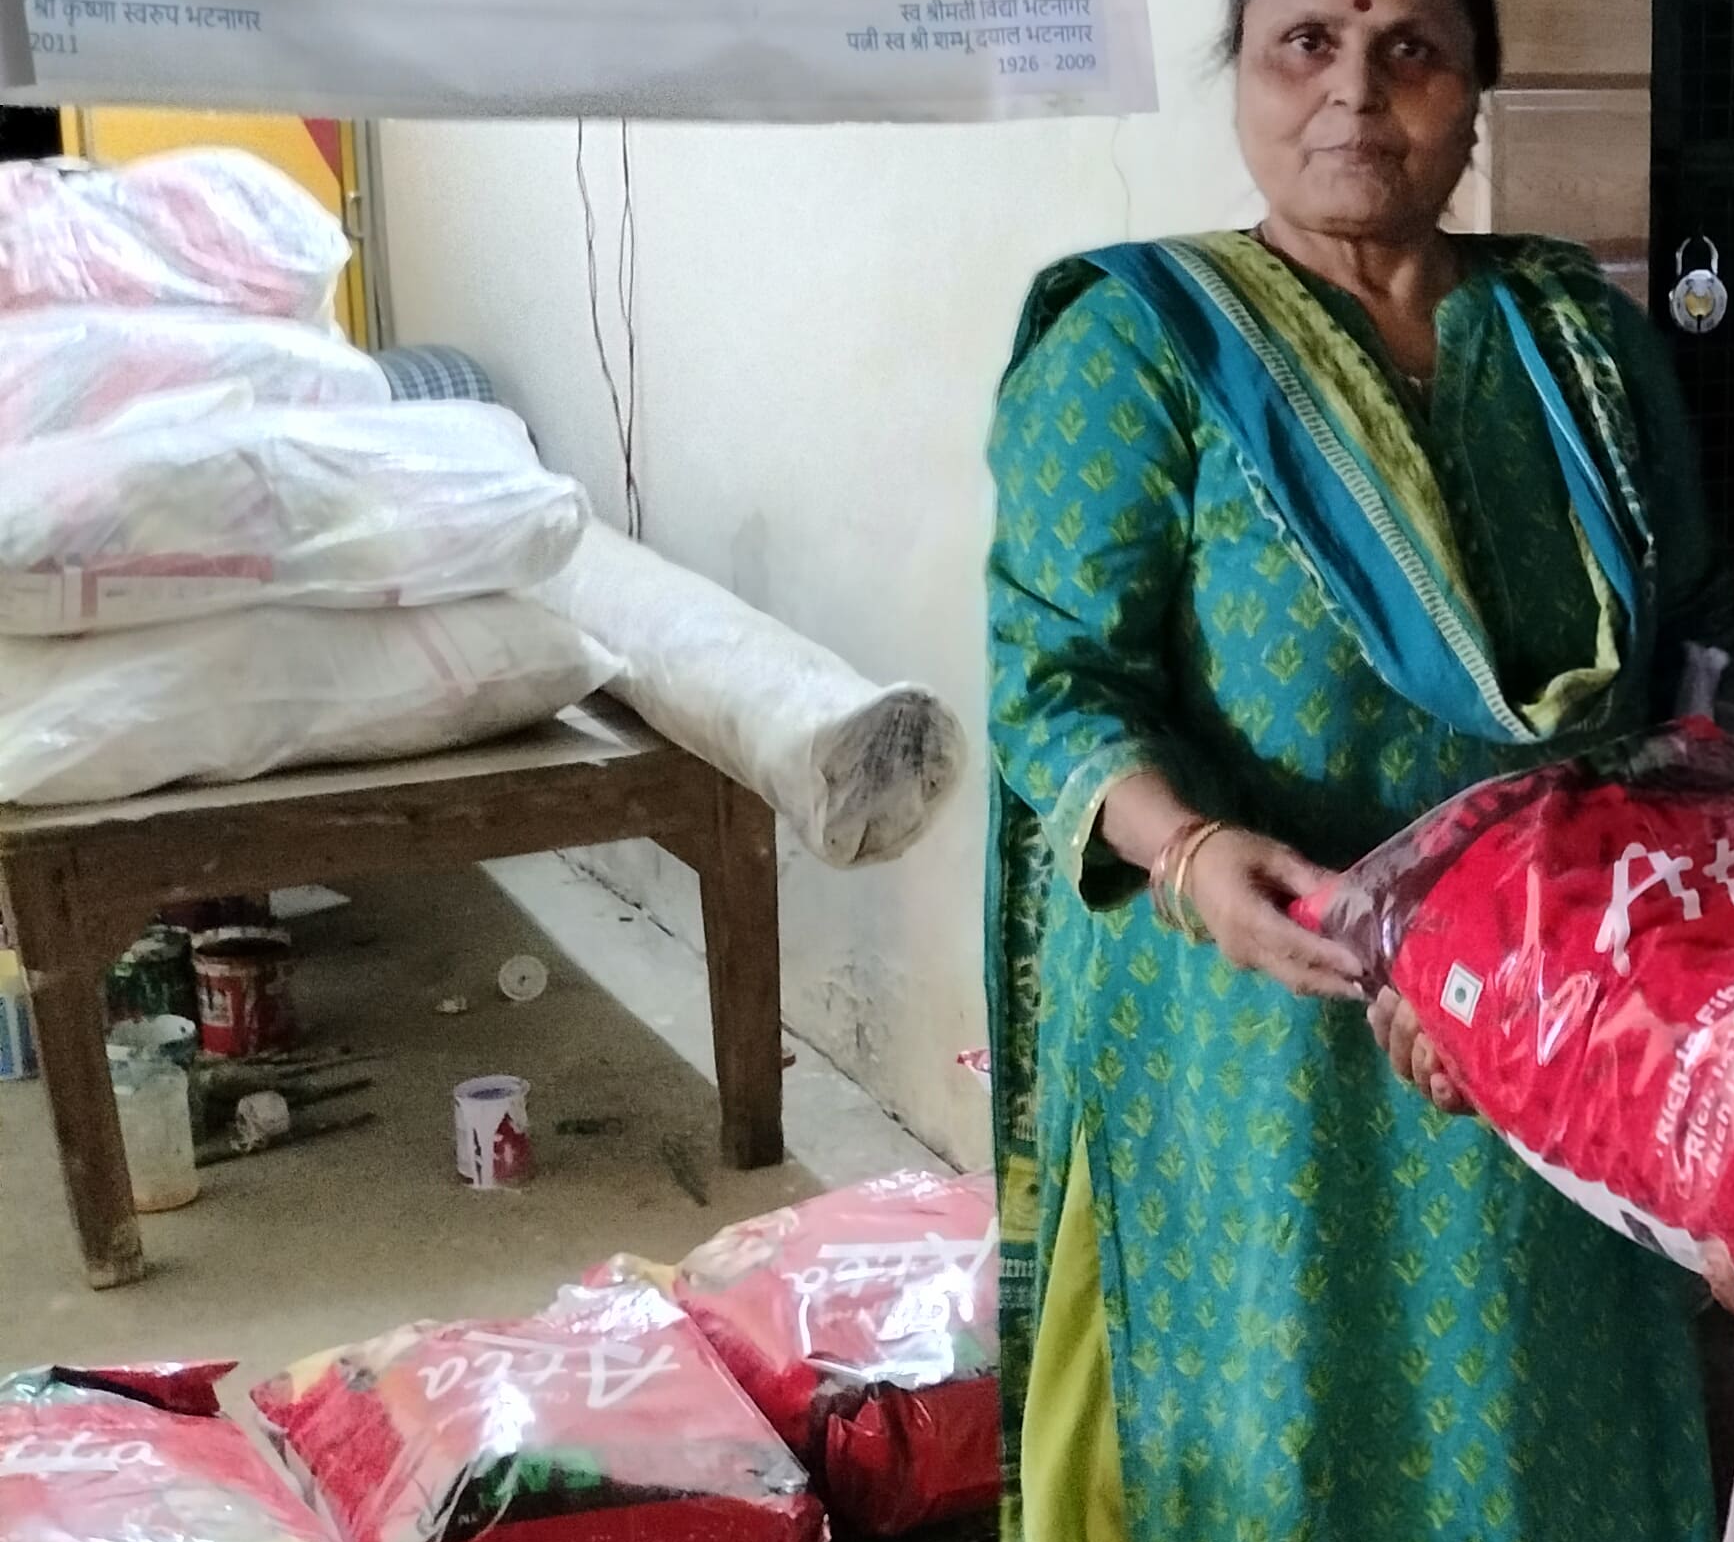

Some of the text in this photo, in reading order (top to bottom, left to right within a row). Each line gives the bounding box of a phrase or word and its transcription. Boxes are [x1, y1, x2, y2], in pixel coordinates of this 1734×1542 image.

[185, 5, 262, 32] भटनागर
[1025, 24, 1094, 44] भटनागर
[998, 55, 1040, 75] 1926
[1055, 53, 1096, 72] 2009
